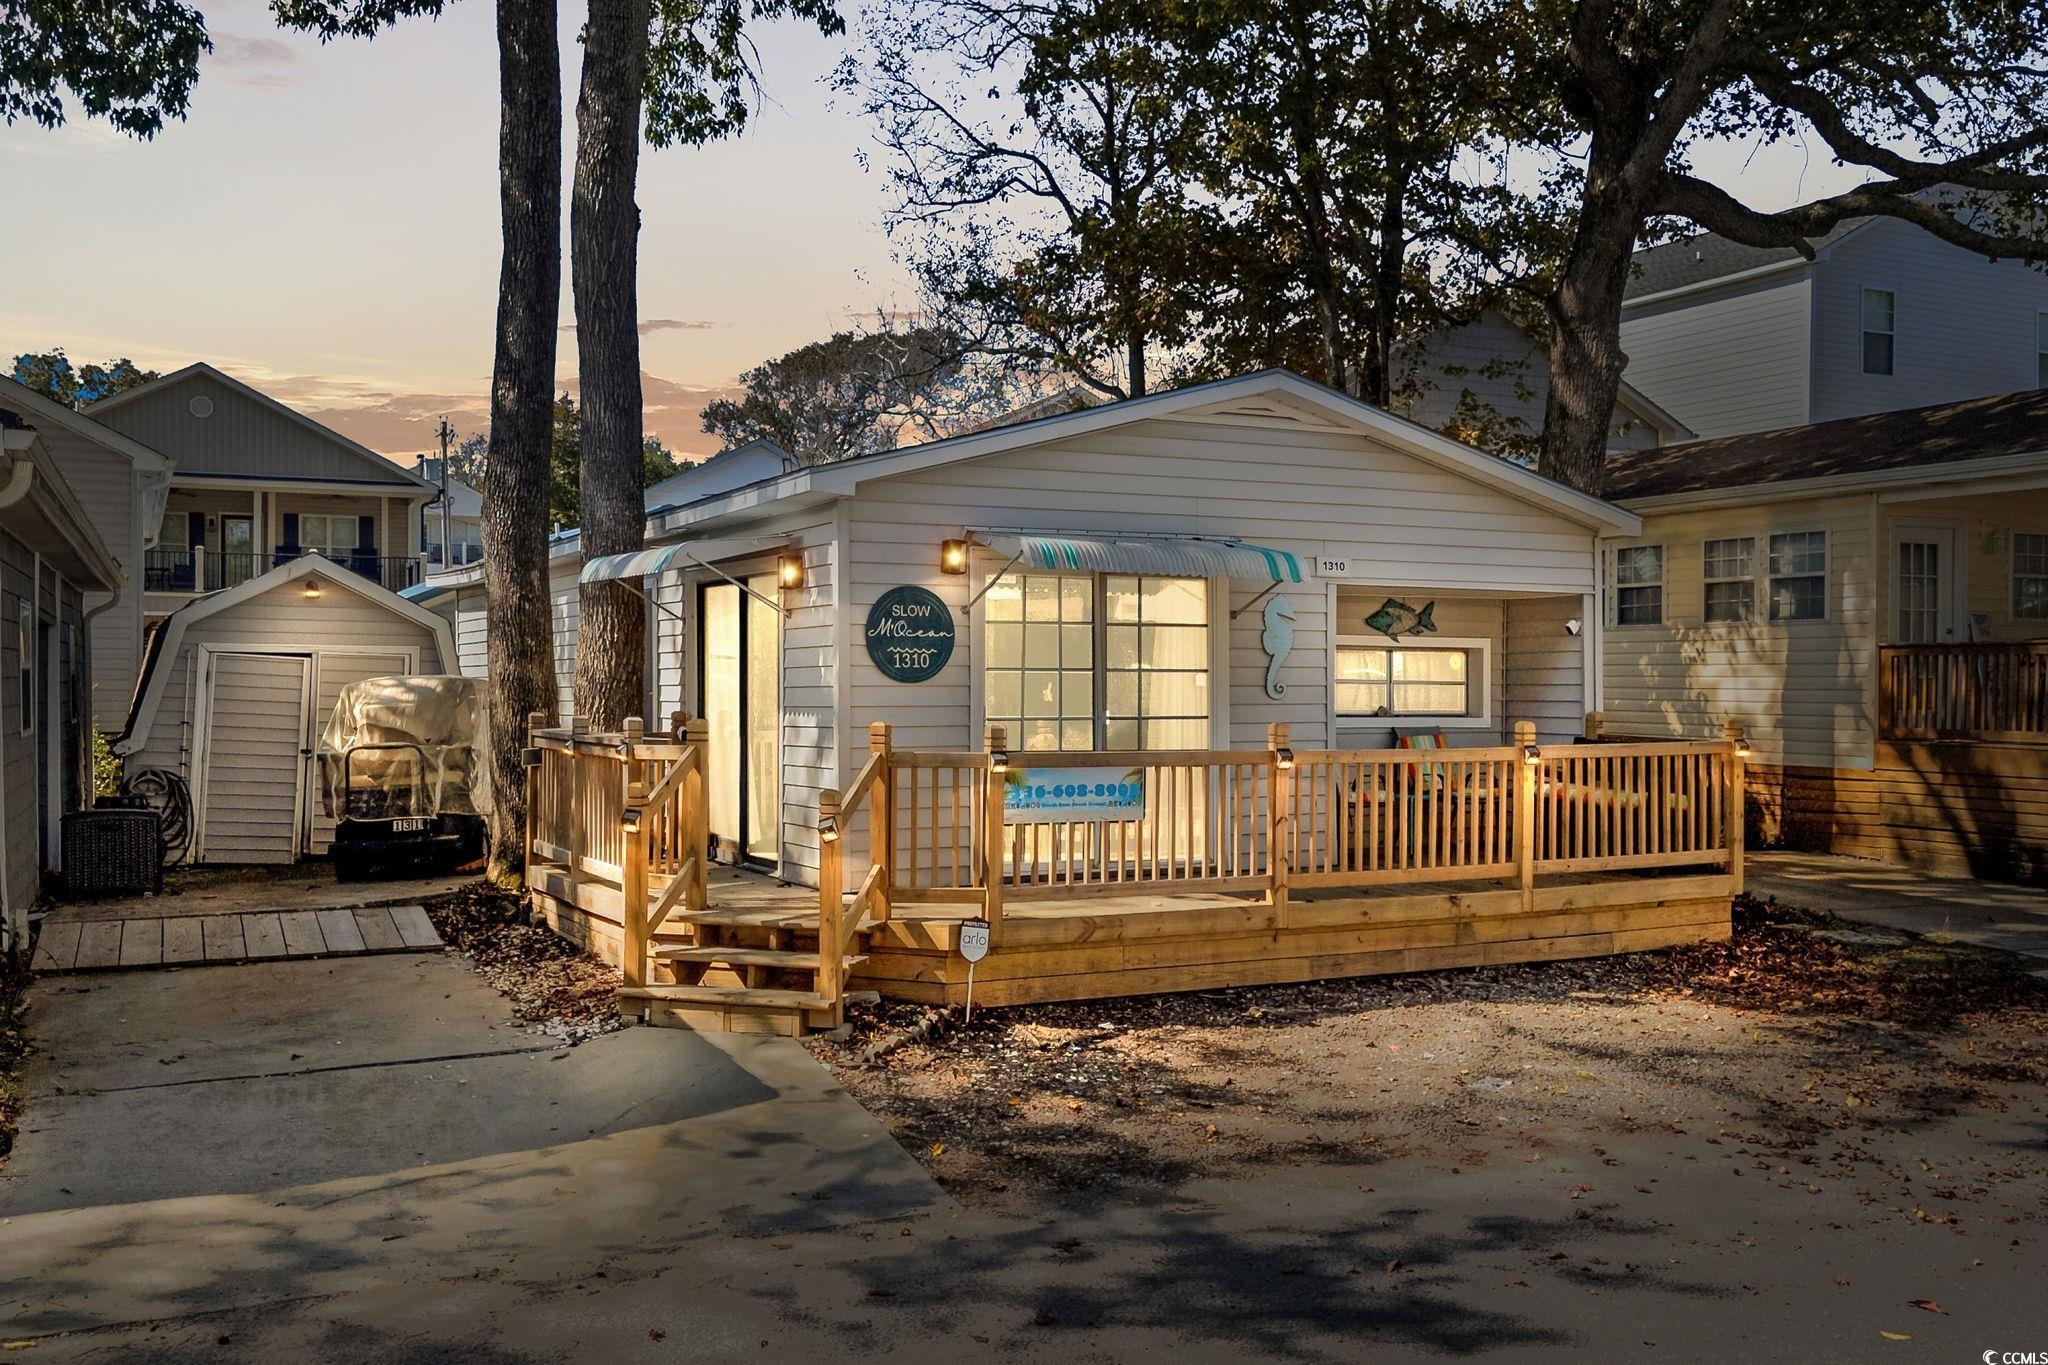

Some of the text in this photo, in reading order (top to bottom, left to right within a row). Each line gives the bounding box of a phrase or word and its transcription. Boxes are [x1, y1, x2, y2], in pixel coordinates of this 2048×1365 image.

[1323, 561, 1345, 571] 1310
[892, 605, 931, 617] SLOW
[868, 617, 954, 637] M'Ocean
[893, 653, 930, 668] 1310
[394, 820, 424, 831] 131
[962, 931, 987, 946] arlo
